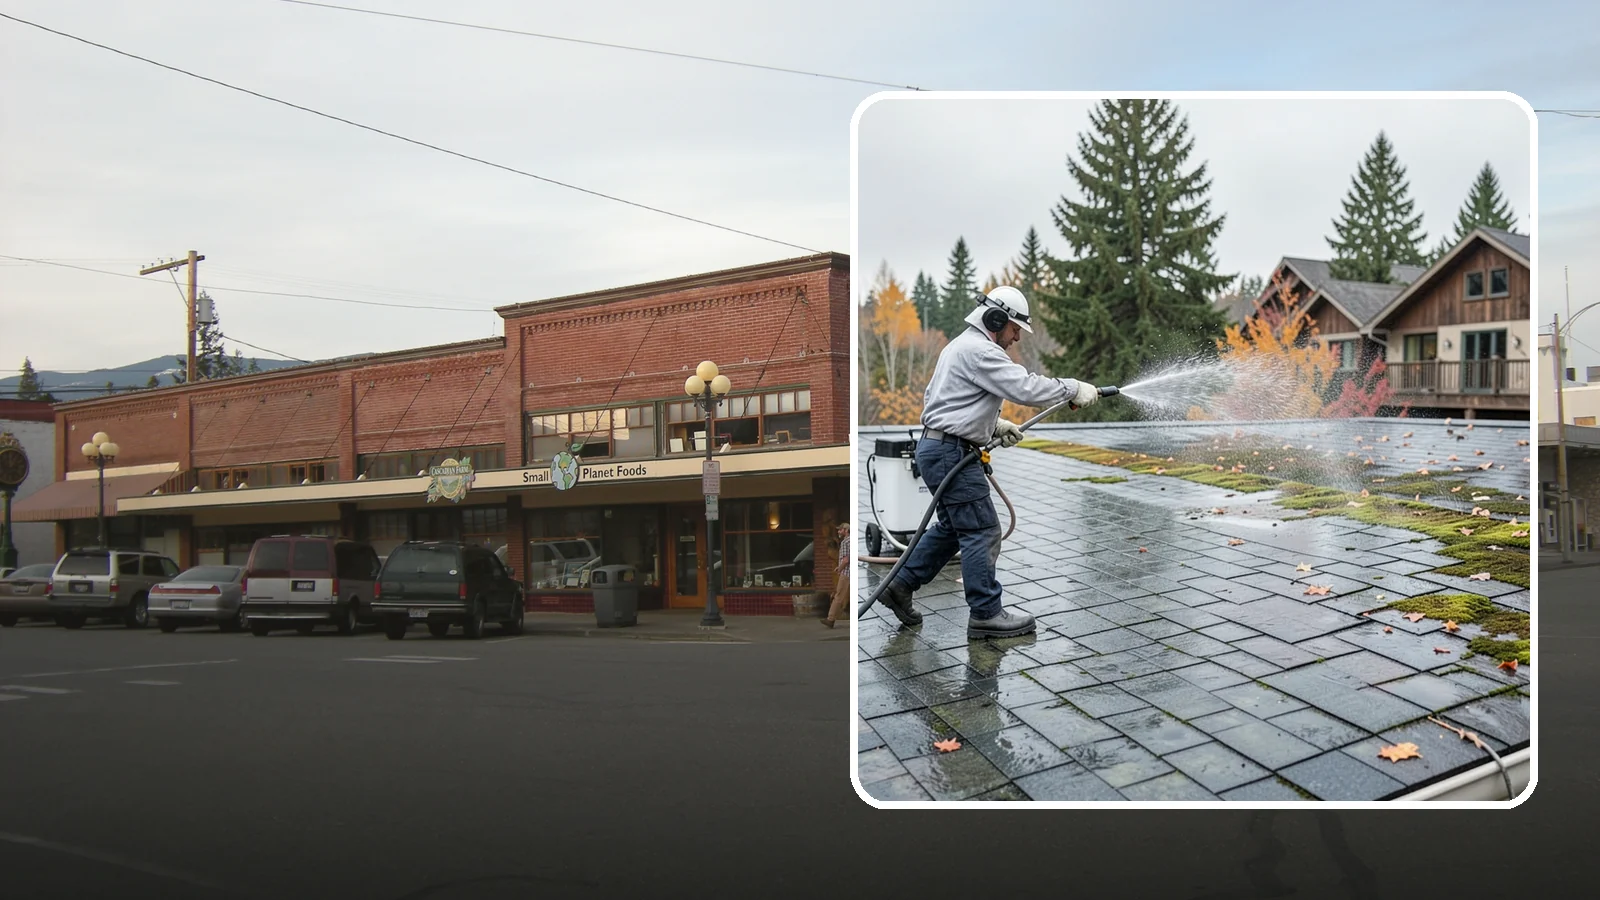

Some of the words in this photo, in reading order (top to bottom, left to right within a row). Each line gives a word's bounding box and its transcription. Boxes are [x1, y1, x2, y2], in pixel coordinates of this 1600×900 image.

[523, 471, 549, 483] Small
[583, 467, 614, 479] Planet
[616, 464, 647, 477] Foods
